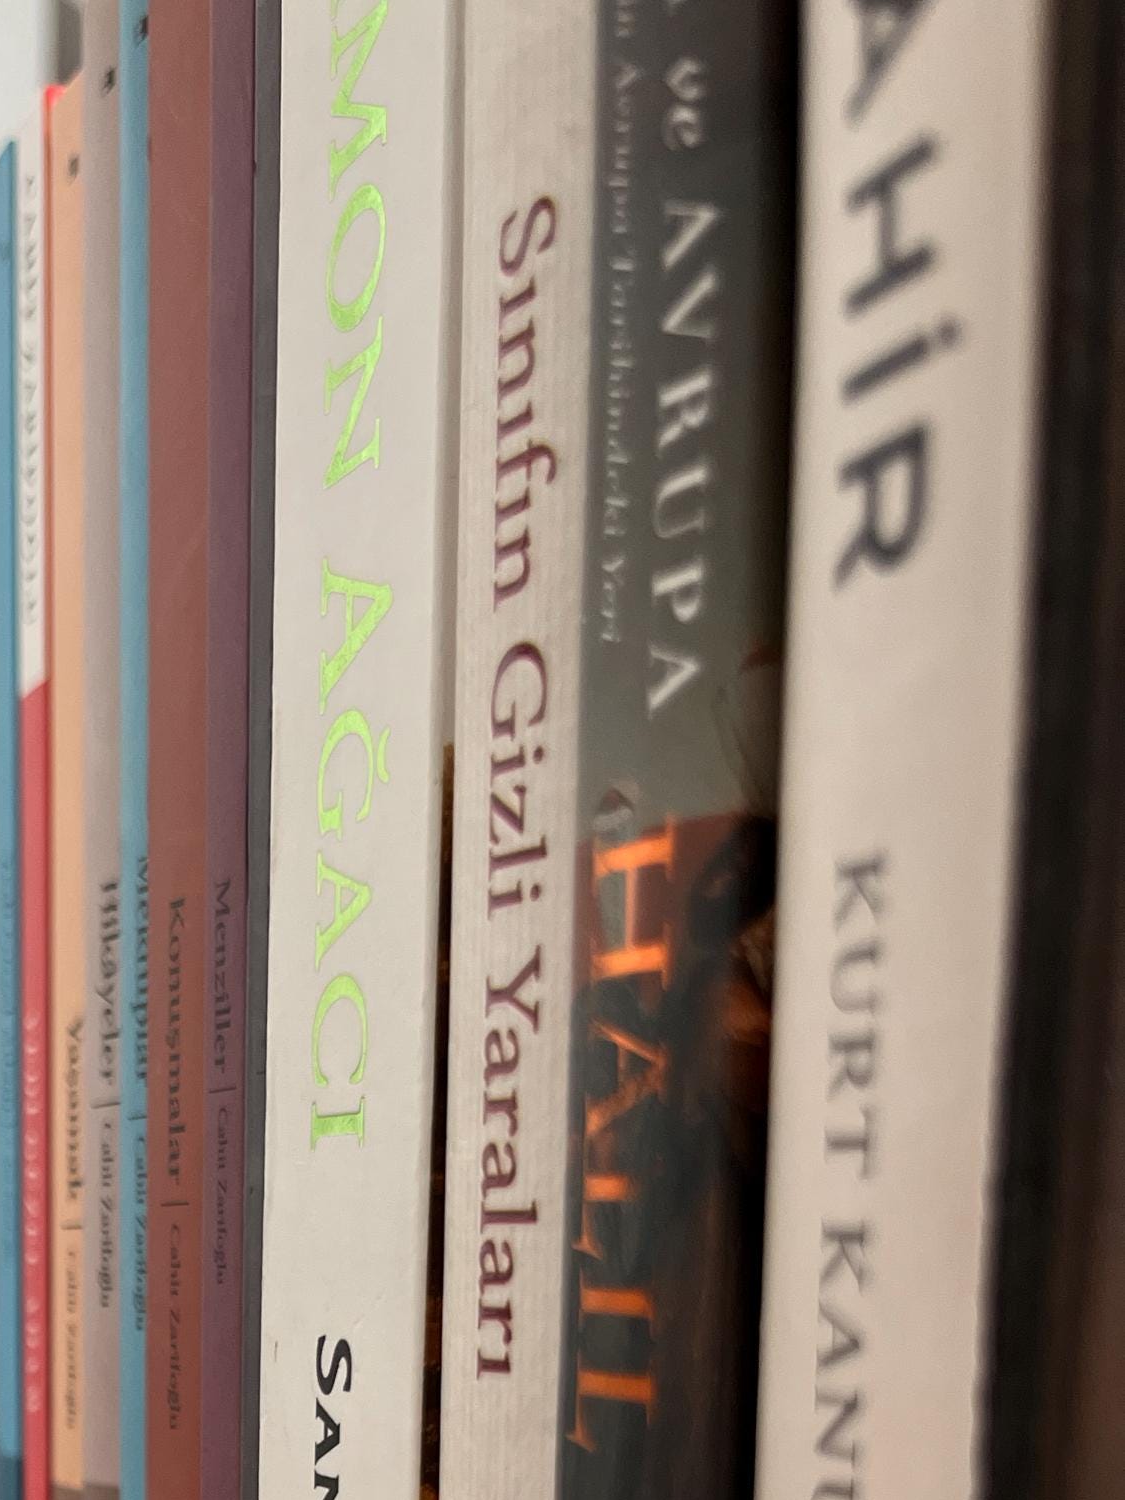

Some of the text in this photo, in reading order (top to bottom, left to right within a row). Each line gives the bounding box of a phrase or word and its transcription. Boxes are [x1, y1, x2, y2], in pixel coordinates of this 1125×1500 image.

[310, 0, 394, 1151] MON AĞACI
[646, 56, 721, 717] ve AVRUPA
[213, 880, 232, 1075] Menziller
[476, 195, 557, 1381] Sınıfın Gizli Yaraları
[824, 850, 887, 1180] KURT
[166, 897, 187, 1186] Konuşmalar
